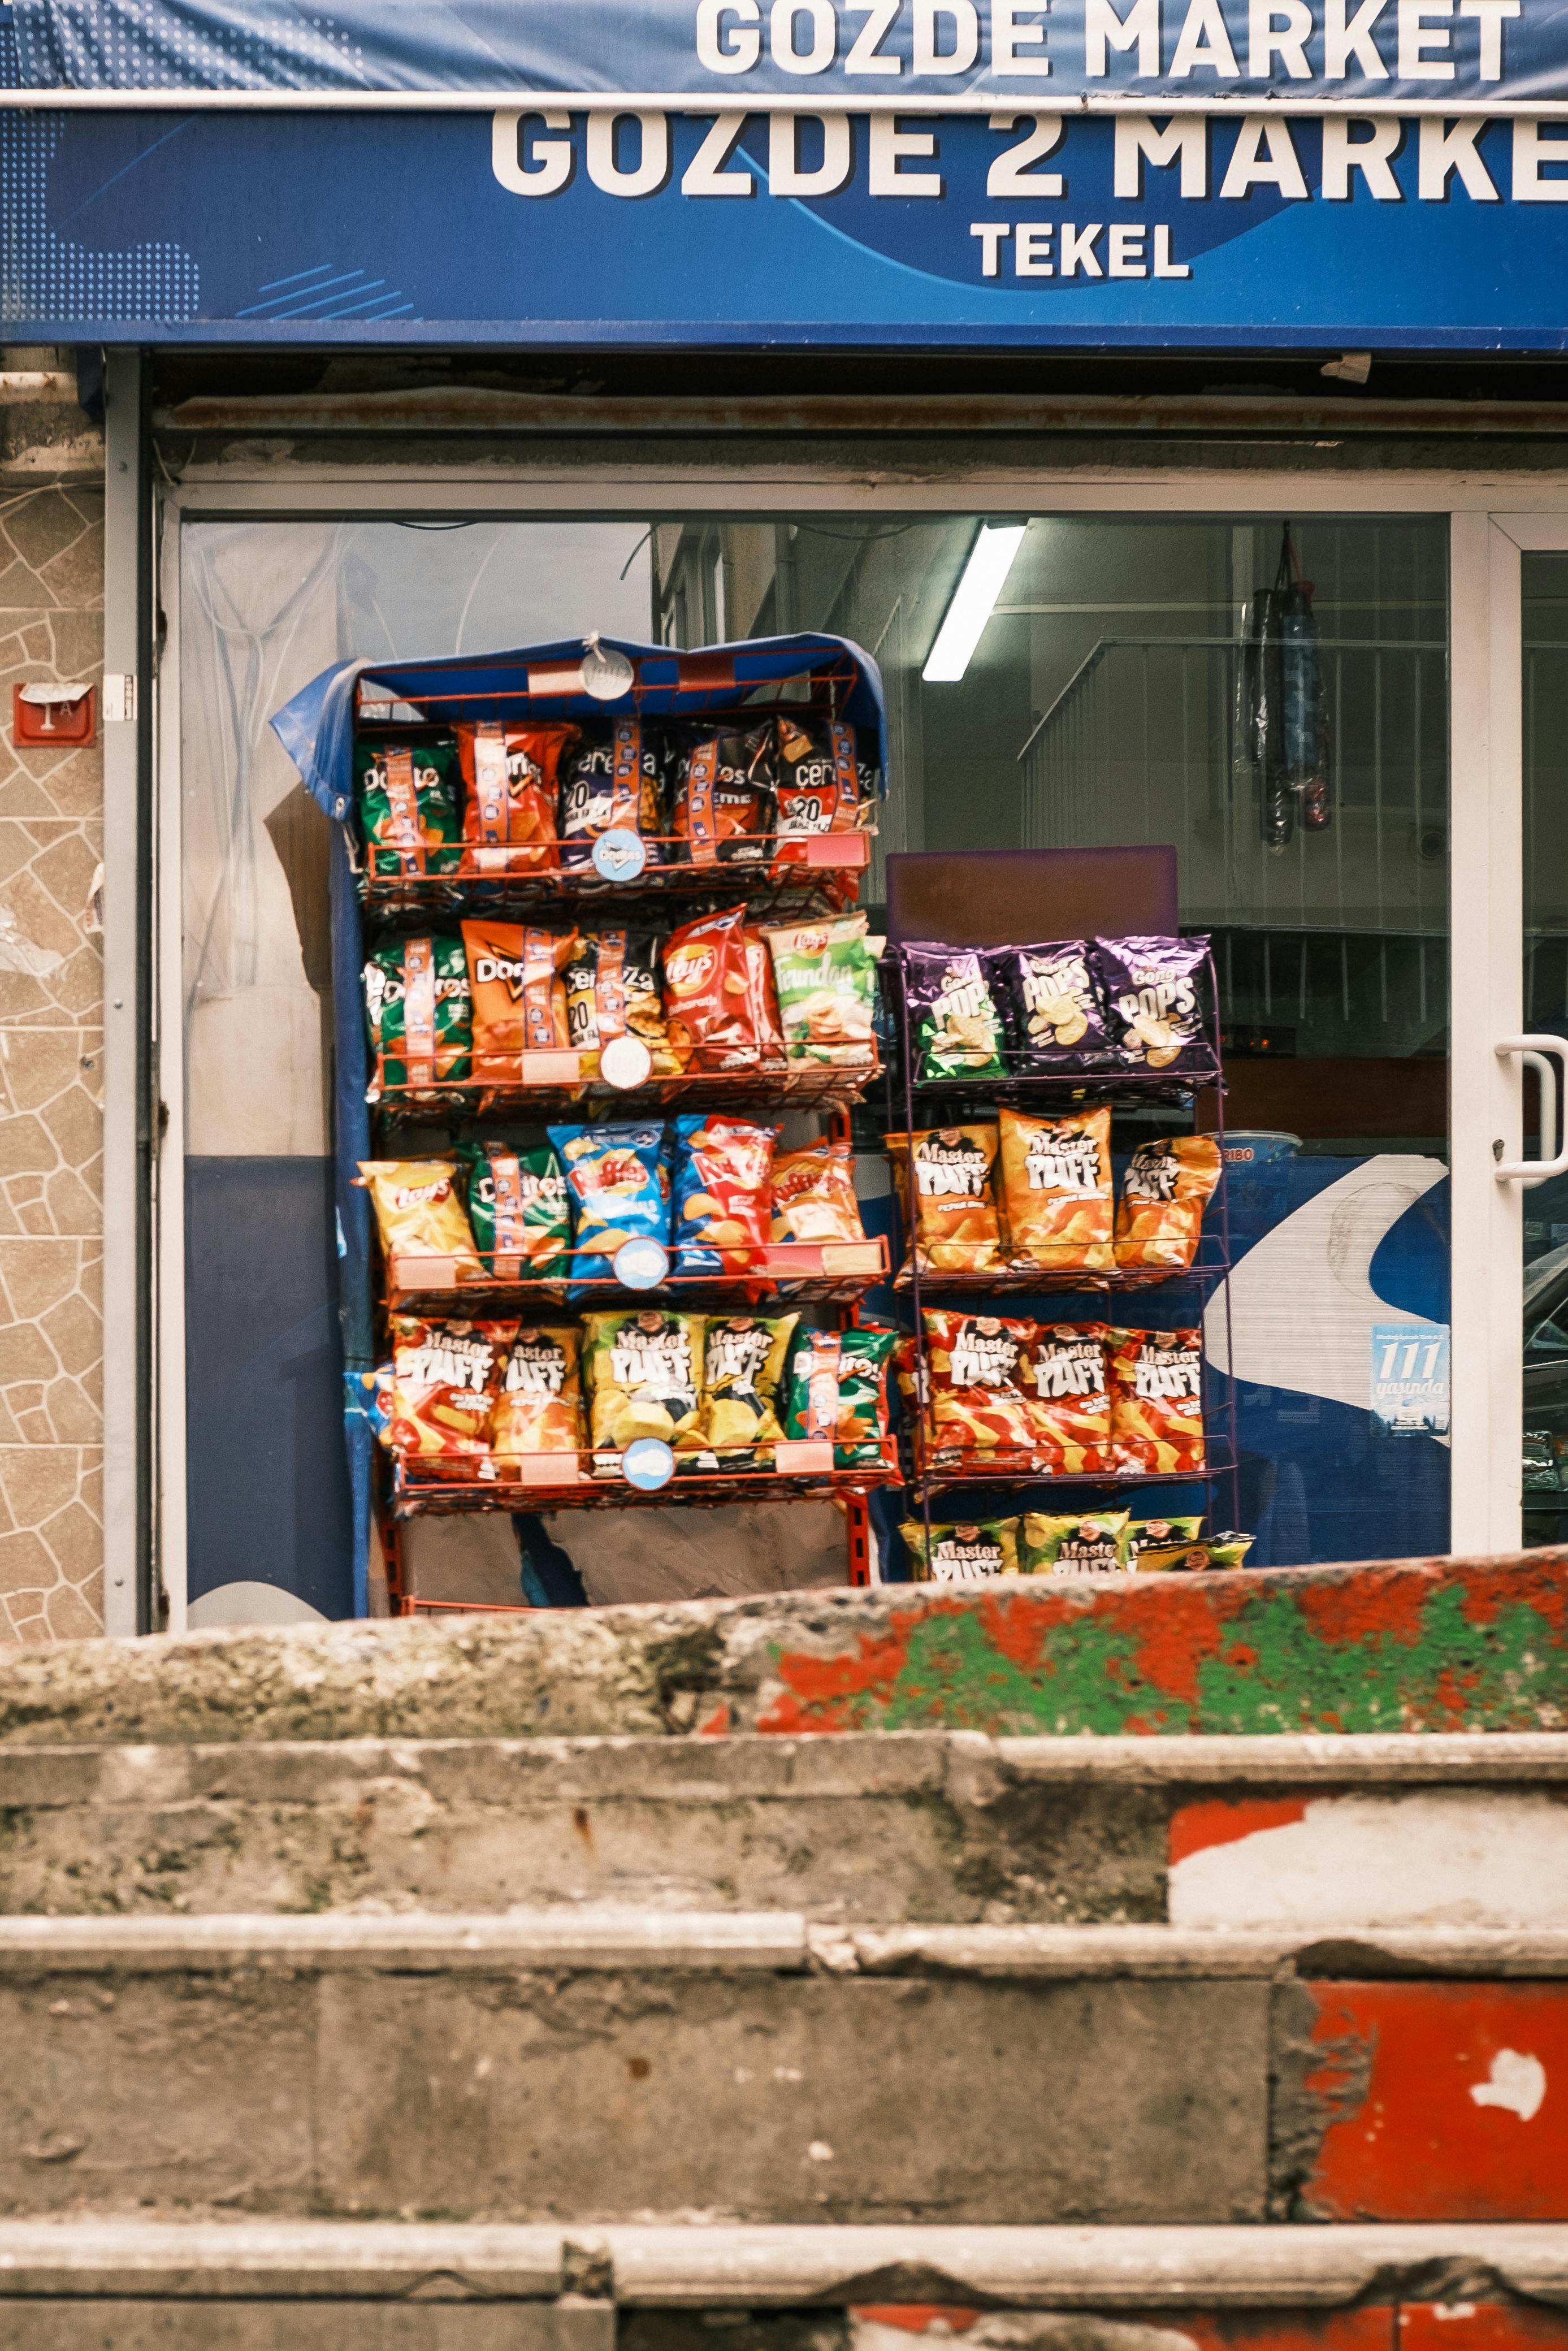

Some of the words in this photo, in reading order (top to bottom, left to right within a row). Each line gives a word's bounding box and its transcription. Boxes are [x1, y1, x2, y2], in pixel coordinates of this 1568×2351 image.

[1085, 0, 1521, 81] MARKET
[986, 112, 1063, 197] 2
[970, 223, 1190, 278] TEKEL
[1022, 958, 1090, 1012] POPS
[1132, 969, 1176, 987] Gong
[1118, 976, 1196, 1023] POPS
[916, 1142, 985, 1164] Master
[1024, 1153, 1101, 1189] PUFF
[1223, 1148, 1254, 1162] RIBO
[915, 1161, 989, 1198] PUFF
[505, 1357, 566, 1393] UFF
[610, 1345, 692, 1383] PUFF
[1033, 1357, 1106, 1397] PUFF
[1380, 1342, 1442, 1379] 111
[1134, 1362, 1201, 1398] PUFF
[936, 1540, 1001, 1561] Master
